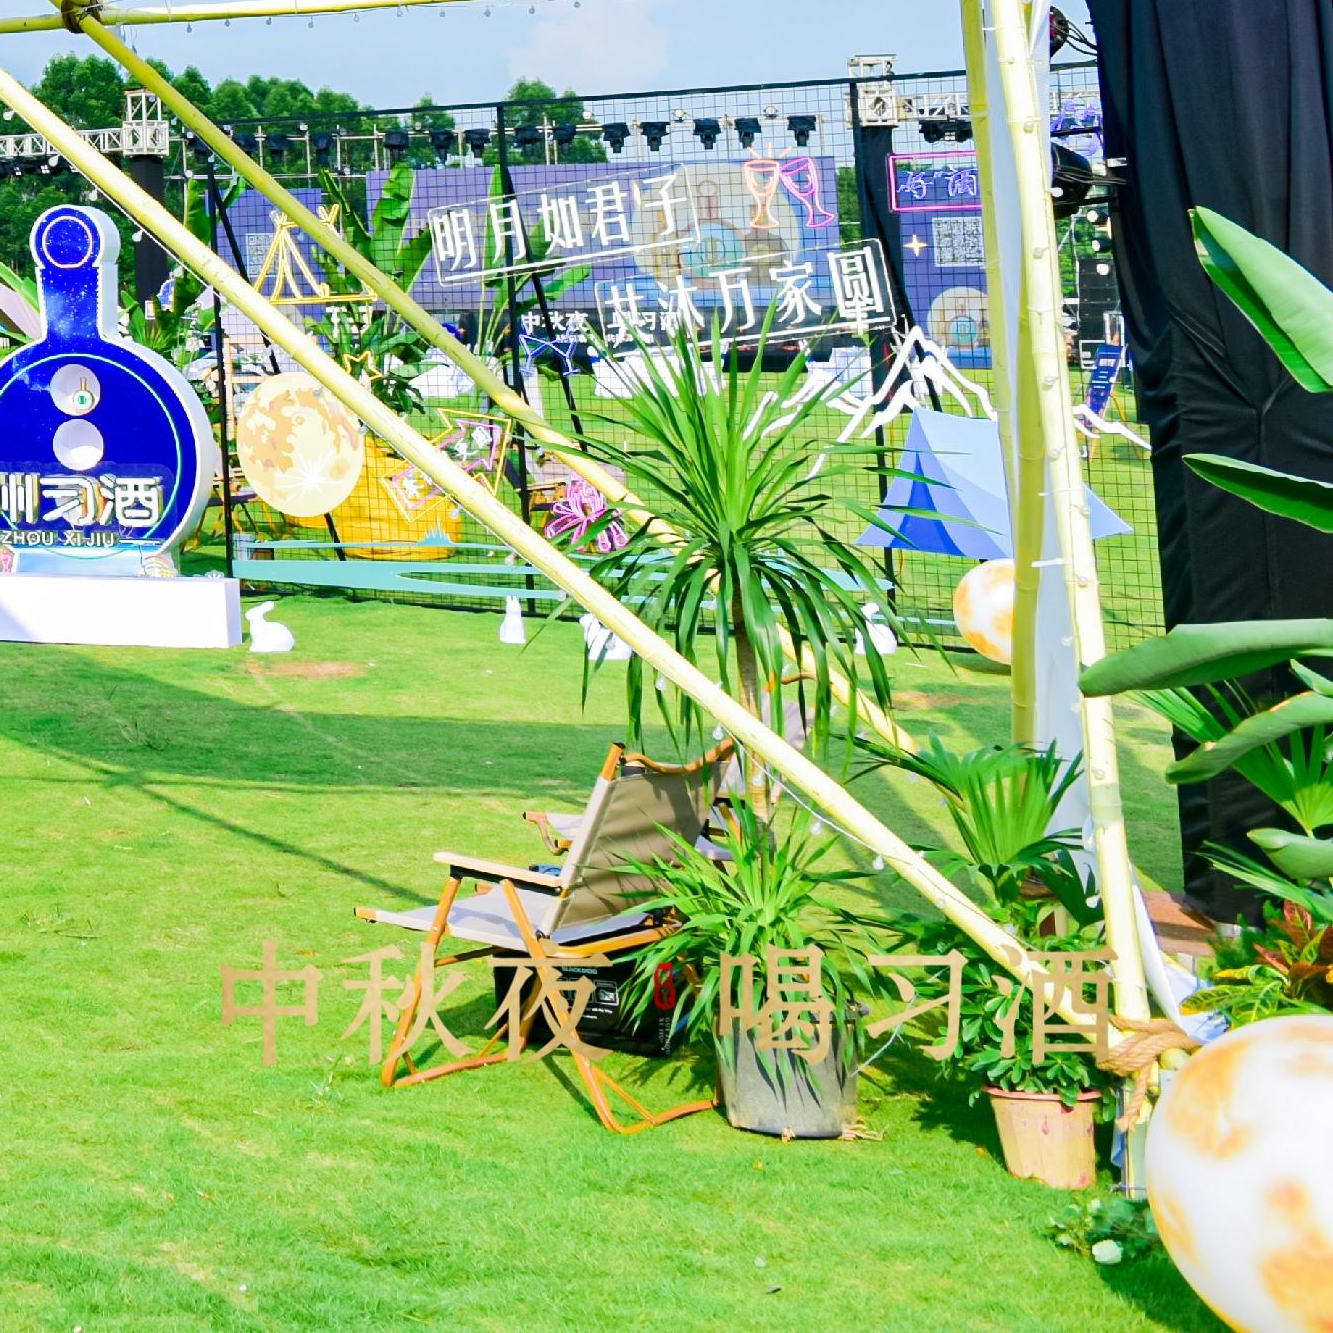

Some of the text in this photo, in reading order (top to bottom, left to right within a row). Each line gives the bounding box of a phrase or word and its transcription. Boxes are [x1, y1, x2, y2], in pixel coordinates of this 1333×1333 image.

[432, 172, 687, 271] 明月如君子
[3, 530, 54, 545] ZHOU
[63, 532, 82, 546] XI
[87, 533, 115, 547] JIU
